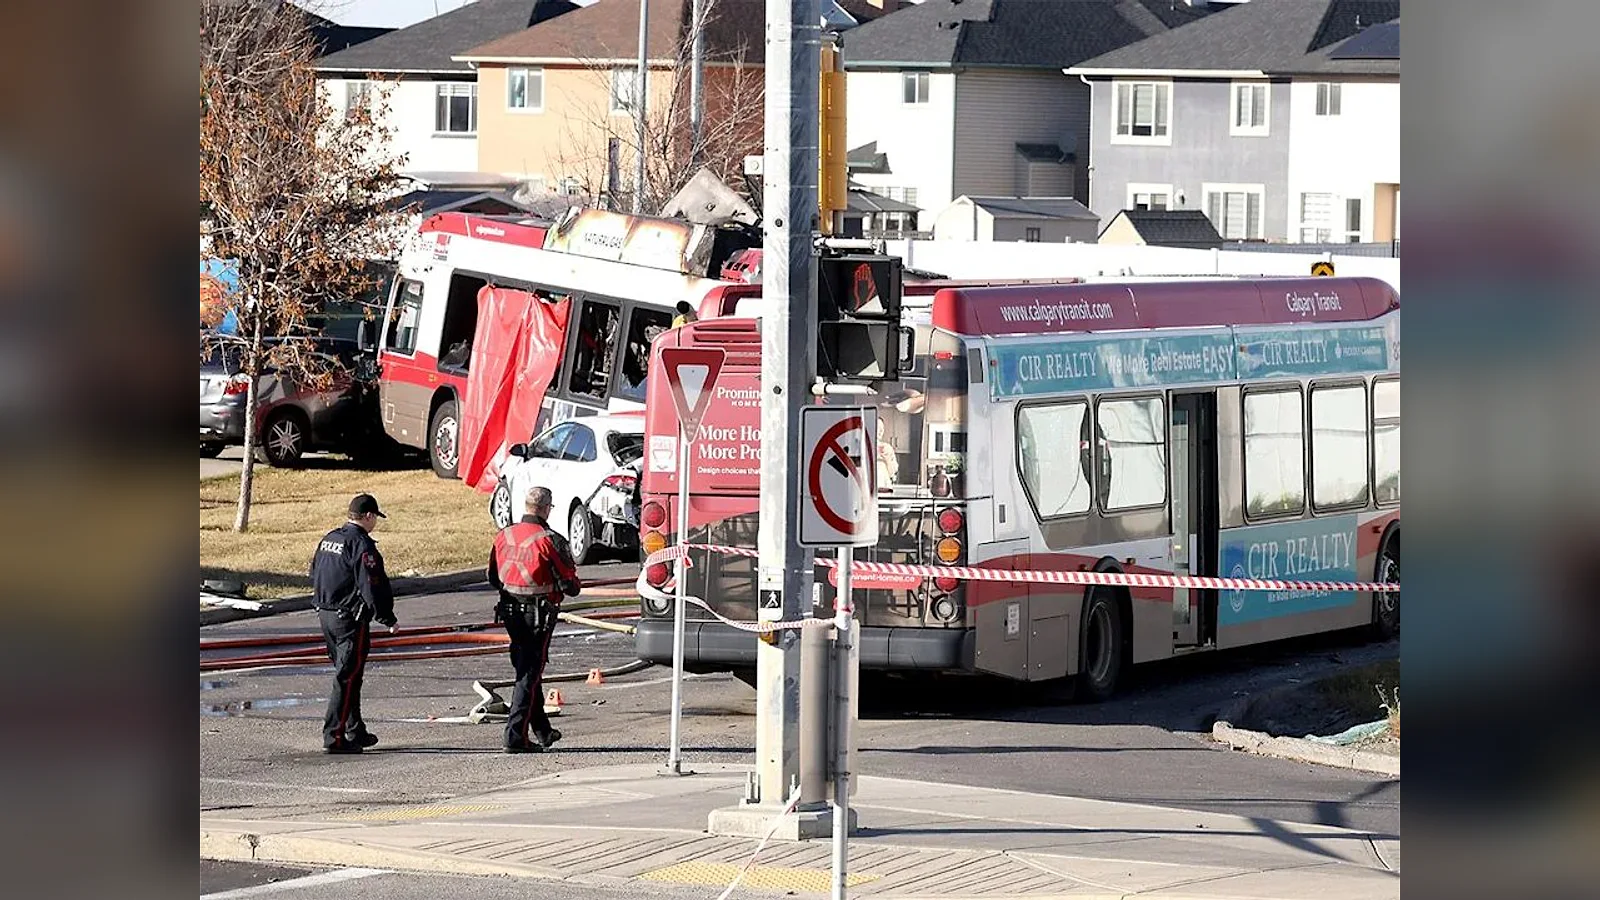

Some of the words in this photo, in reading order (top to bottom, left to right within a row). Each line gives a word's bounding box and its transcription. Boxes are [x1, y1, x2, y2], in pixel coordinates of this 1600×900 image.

[1000, 298, 1114, 327] www.calgarytransit.com
[1285, 292, 1317, 316] Calgary
[1314, 290, 1342, 312] Transit
[1106, 355, 1122, 375] We
[1122, 354, 1150, 374] Make
[1151, 351, 1172, 373] Real
[1173, 348, 1201, 371] Estate
[1203, 344, 1234, 374] EASY
[1262, 342, 1286, 366] CIR
[1286, 339, 1329, 365] REALTY
[1018, 355, 1042, 382] CIR
[1045, 351, 1098, 380] REALTY
[717, 386, 761, 399] Promin
[699, 424, 737, 441] More
[740, 425, 761, 441] Ho
[699, 443, 738, 460] More
[740, 443, 761, 460] Pro
[697, 466, 720, 476] Design
[721, 466, 747, 475] choices
[320, 540, 344, 555] POLICE
[1248, 541, 1279, 580] CIR
[1284, 531, 1354, 576] REALTY
